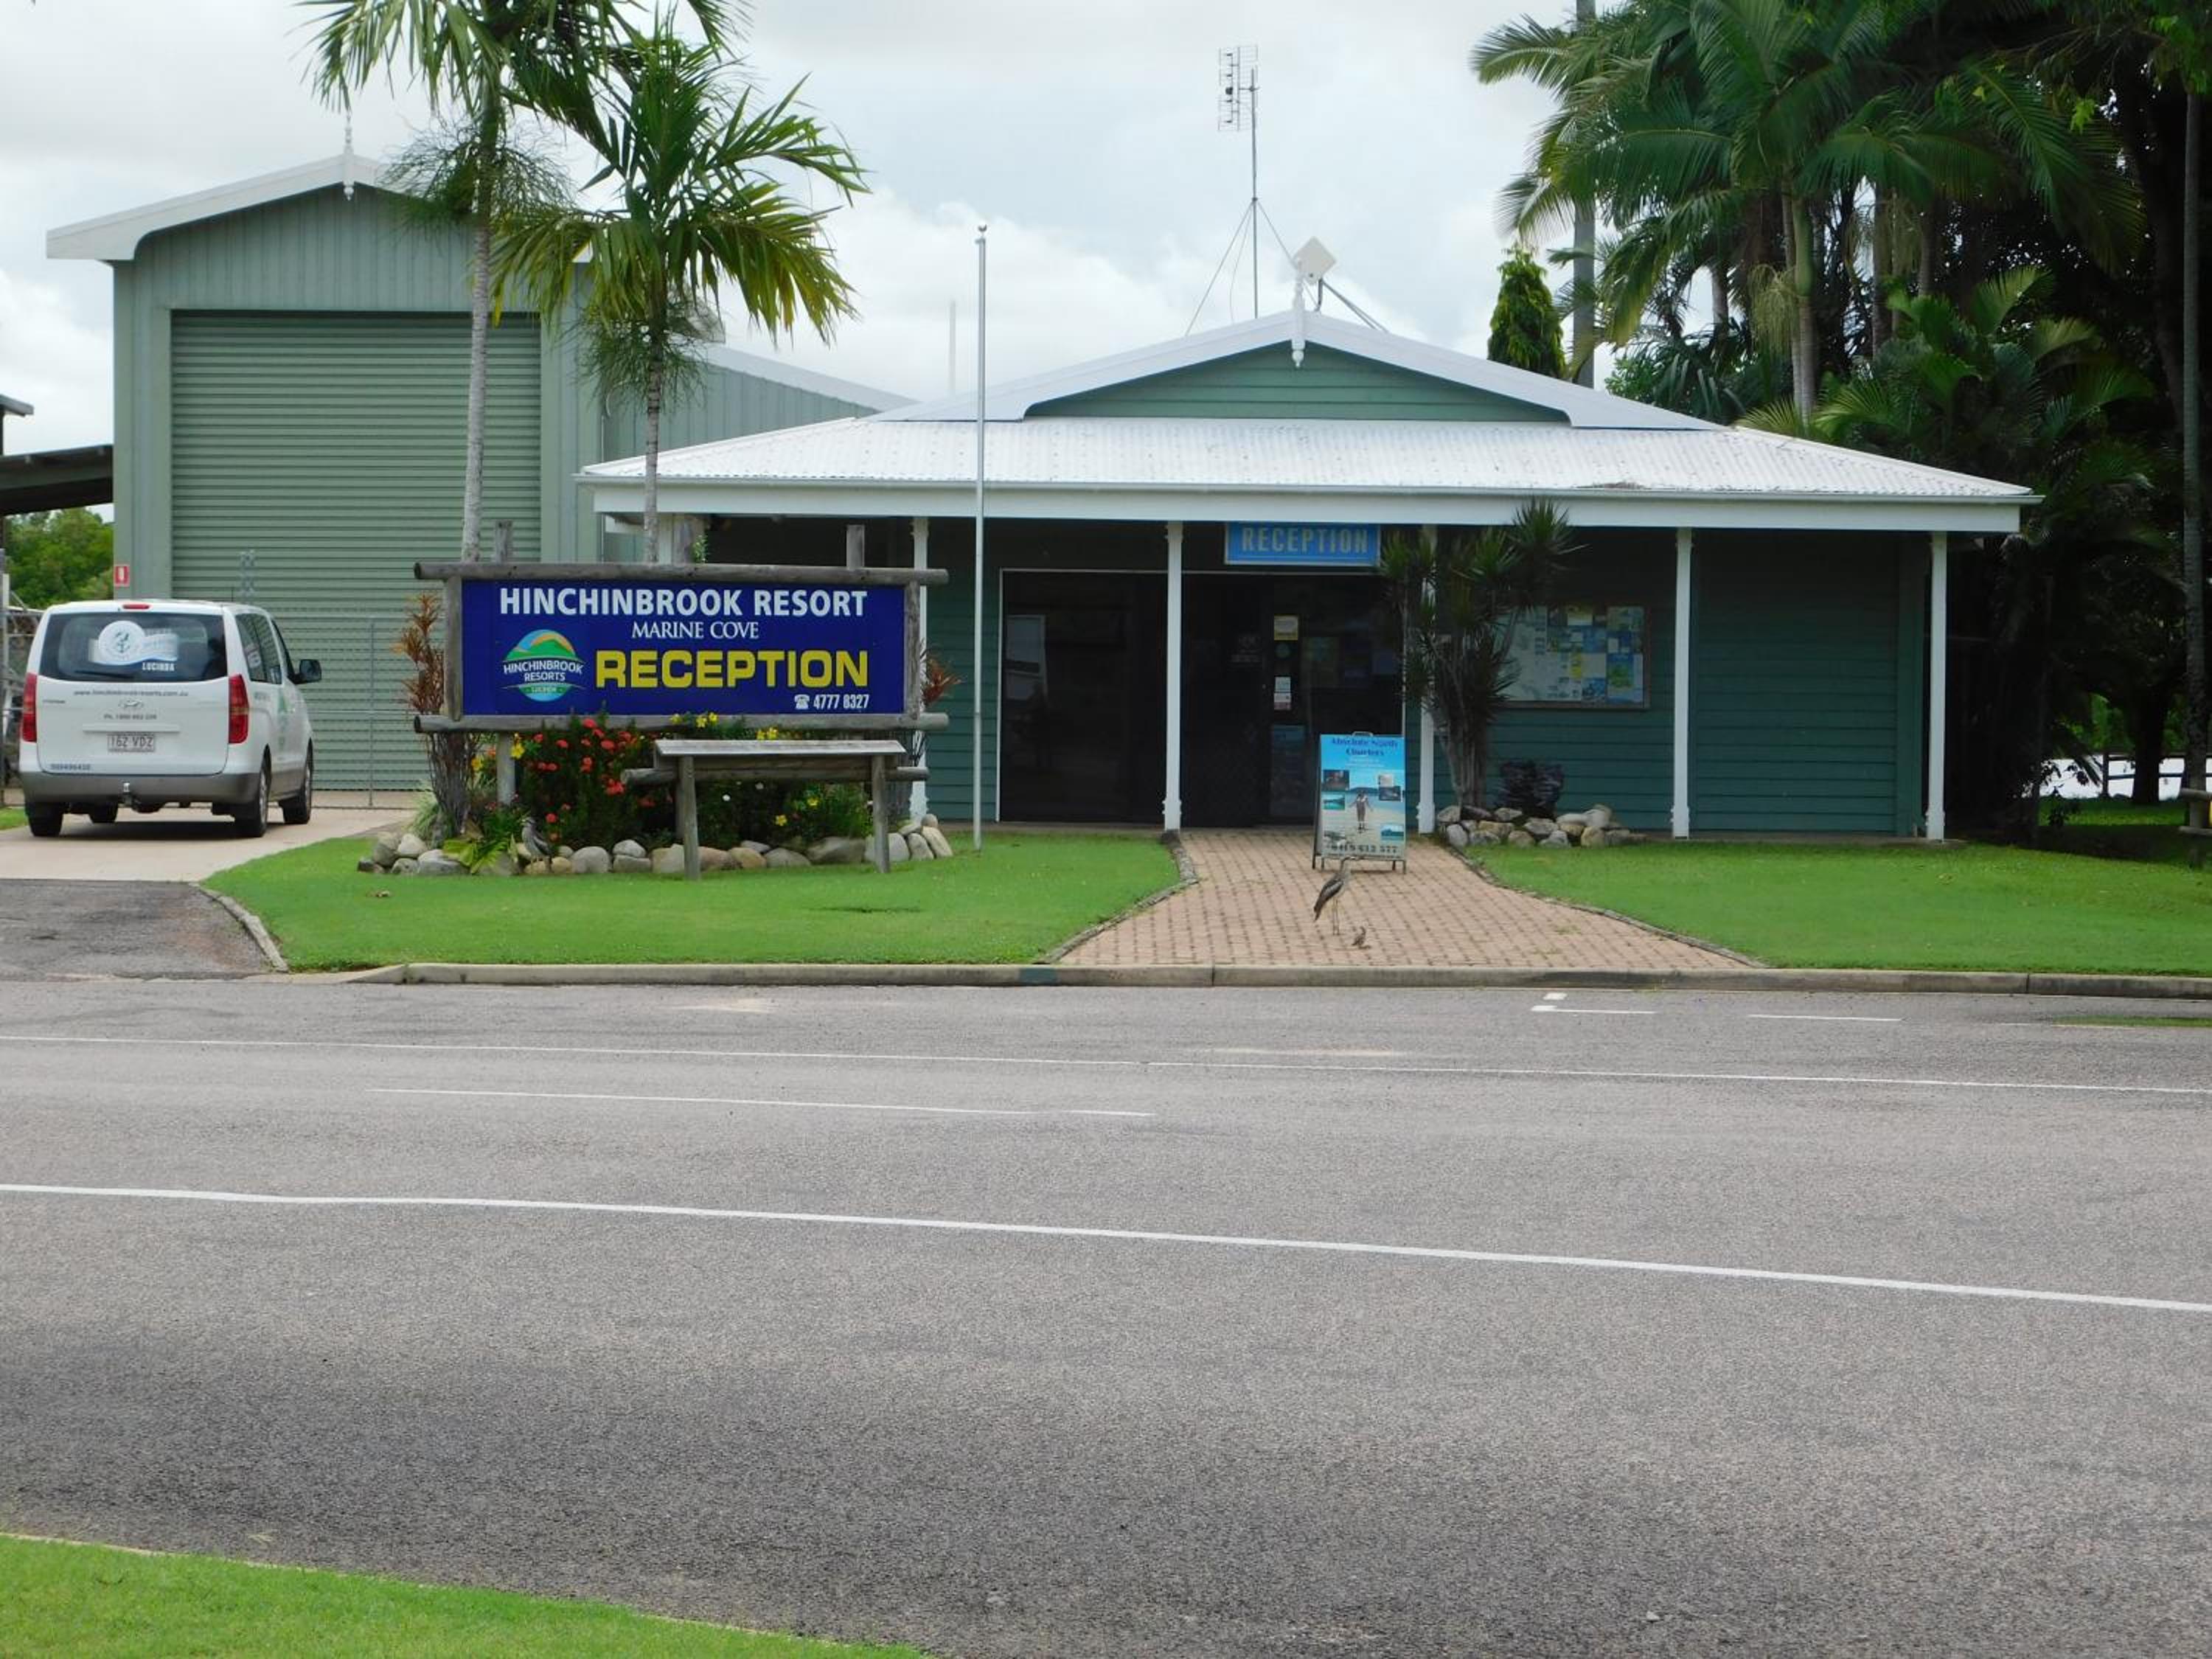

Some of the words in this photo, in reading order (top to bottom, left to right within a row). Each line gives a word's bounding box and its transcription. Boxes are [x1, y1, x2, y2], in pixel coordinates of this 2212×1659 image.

[1241, 526, 1368, 553] RECEPTION
[500, 588, 742, 616] HINCHINBROOK
[754, 589, 868, 617] RESORT
[632, 621, 704, 639] MARINE
[710, 621, 759, 639] COVE
[503, 659, 584, 675] HINCHINBROOK
[596, 650, 868, 688] RECEPTION
[524, 672, 566, 681] RESORTS
[813, 694, 841, 709] 4777
[843, 694, 869, 709] 8327
